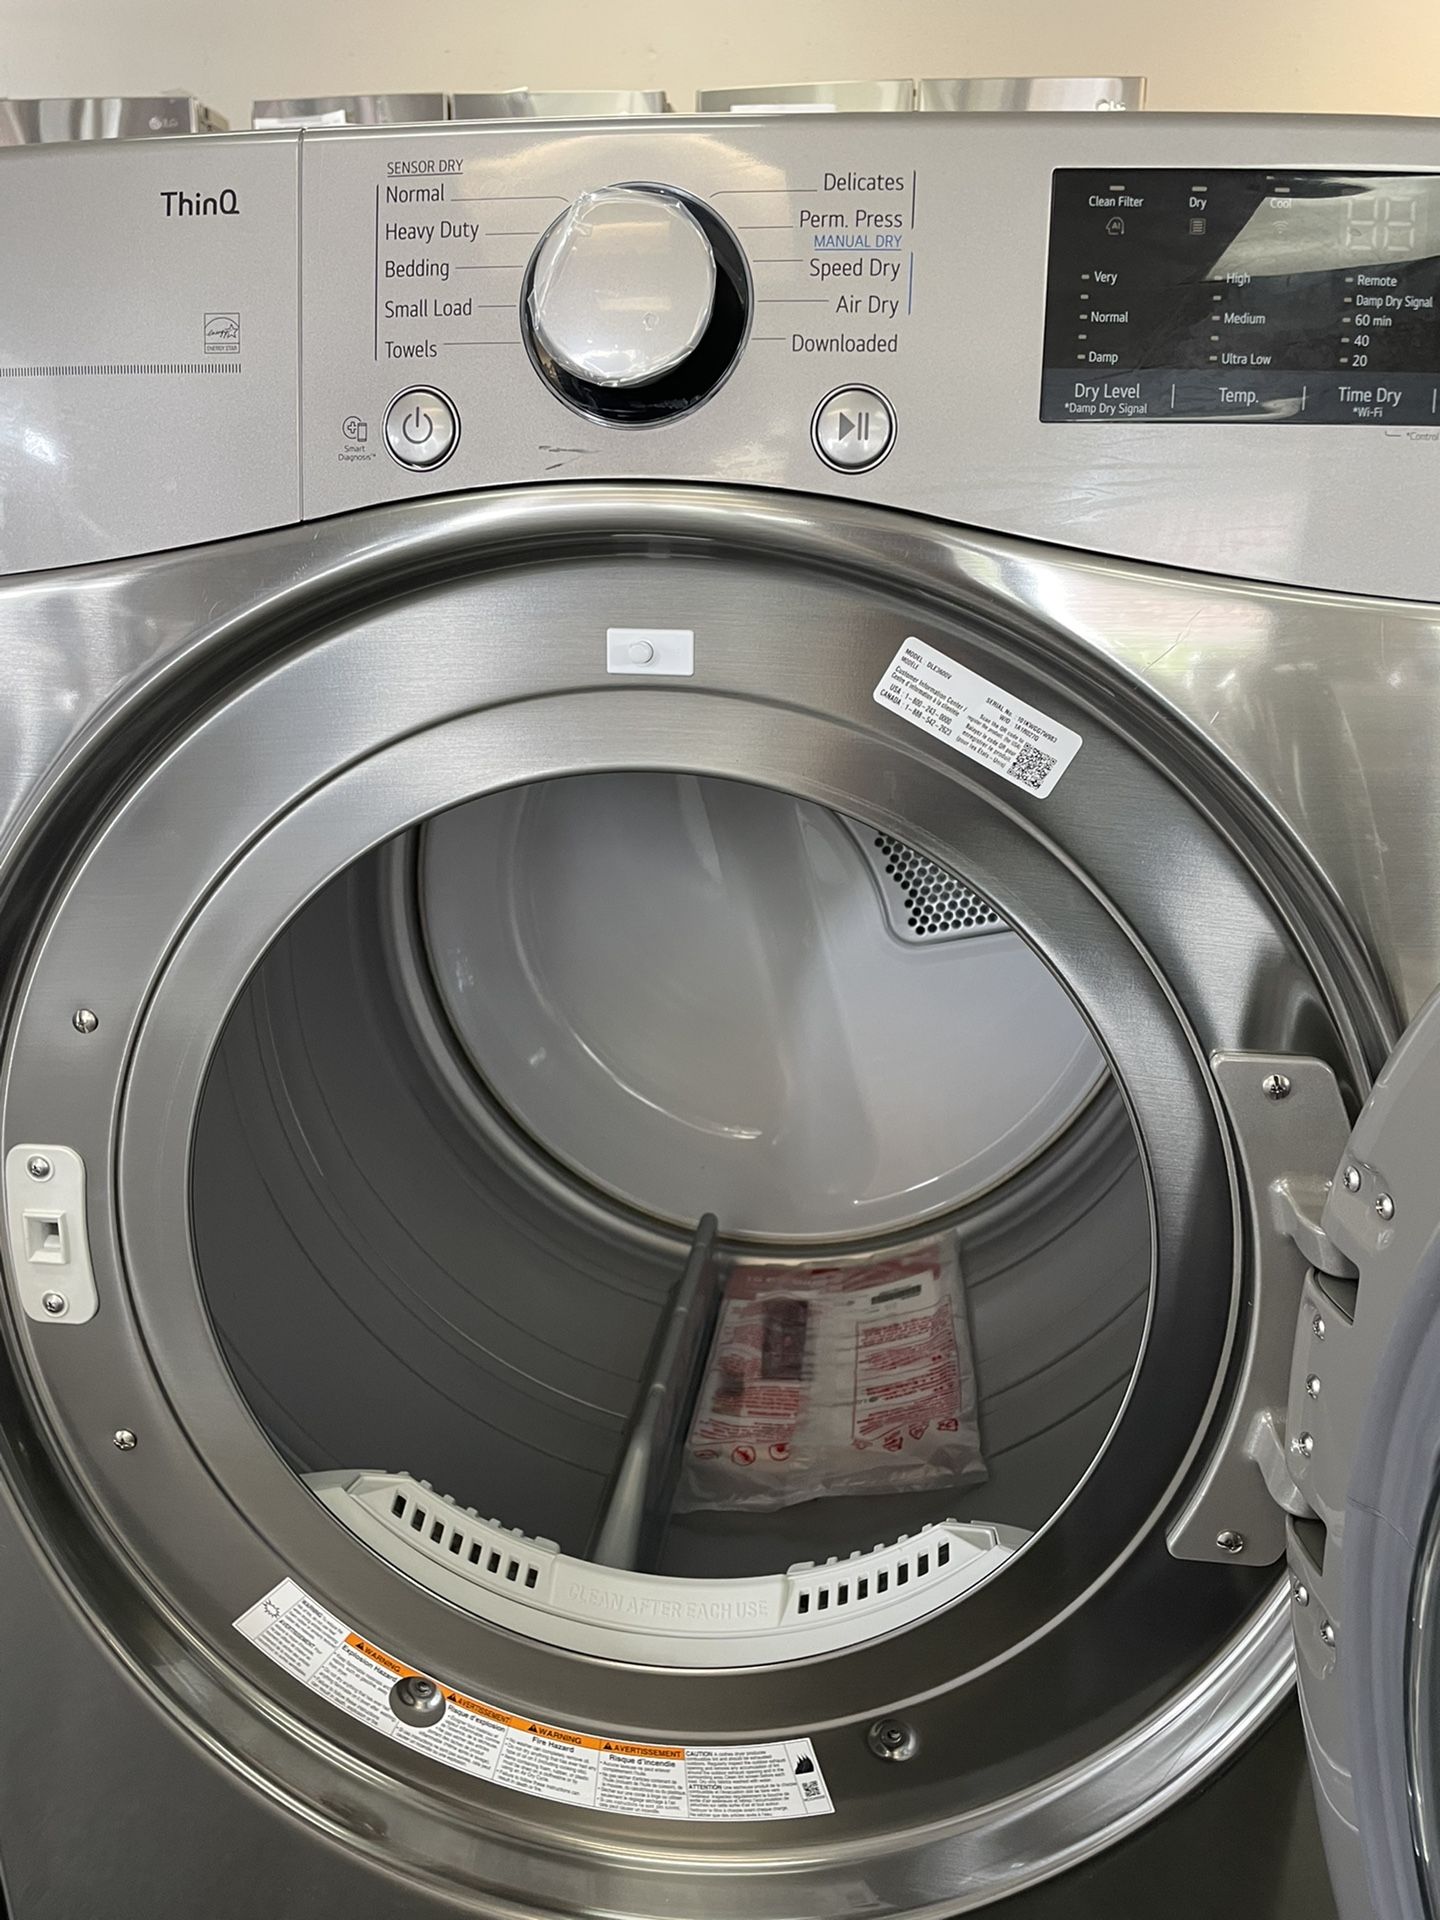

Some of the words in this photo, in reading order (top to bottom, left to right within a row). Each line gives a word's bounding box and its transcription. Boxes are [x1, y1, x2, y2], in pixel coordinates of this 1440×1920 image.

[387, 160, 435, 175] SENSOR
[438, 159, 464, 173] DRY
[824, 172, 904, 191] Delicates
[386, 183, 445, 203] Normal
[160, 189, 240, 217] ThinQ
[1088, 195, 1116, 208] Clean
[1118, 195, 1144, 208] Filter
[1189, 196, 1207, 210] Dry
[1270, 197, 1292, 209] Cool
[800, 209, 849, 228] Perm.
[855, 209, 903, 228] Press
[385, 223, 435, 244] Heavy
[440, 220, 479, 243] Duty
[814, 235, 871, 248] MANUAL
[875, 235, 903, 248] DRY
[385, 259, 450, 281] Bedding
[809, 258, 863, 281] Speed
[869, 258, 901, 282] Dry
[1094, 271, 1118, 285] Very
[1226, 272, 1251, 286] High
[1357, 274, 1398, 287] Remote
[385, 299, 428, 318] Small
[434, 298, 472, 317] Load
[835, 295, 862, 314] Air
[868, 295, 899, 319] Dry
[1356, 294, 1383, 309] Damp
[1385, 295, 1402, 310] Dry
[1404, 295, 1433, 311] Signal
[1090, 311, 1129, 323] Normal
[1223, 312, 1266, 325] Medium
[1354, 314, 1370, 327] 60
[1372, 315, 1393, 327] min
[792, 333, 898, 353] Downloaded
[1353, 334, 1370, 347] 40
[385, 339, 438, 359] Towels
[1088, 351, 1119, 365] Damp
[1221, 352, 1248, 365] Ultra
[1250, 352, 1272, 365] Low
[1352, 354, 1368, 367] 20
[1074, 382, 1100, 402] Dry
[1103, 383, 1140, 399] Level
[1218, 387, 1259, 406] Temp.
[1338, 386, 1372, 402] Time
[1376, 387, 1402, 407] Dry
[1099, 402, 1116, 416] Dry
[1118, 402, 1148, 417] Signal
[344, 445, 365, 453] Smart
[904, 648, 923, 662] MODEL
[888, 683, 902, 694] USA
[894, 665, 919, 683] Customer
[918, 679, 947, 700] Information
[946, 696, 964, 710] Center
[879, 688, 902, 705] CANADA
[985, 696, 1004, 711] SERIAL
[568, 1583, 624, 1611] CLEAN
[627, 1597, 682, 1618] AFTER
[686, 1601, 734, 1620] EACH
[736, 1599, 768, 1619] USE
[341, 1643, 374, 1669] Explosion
[373, 1665, 397, 1682] Hazard
[363, 1646, 401, 1673] WARNING
[447, 1704, 469, 1719] Risque
[457, 1697, 510, 1724] AVERTISSEMENT
[537, 1727, 582, 1744] WARNING
[531, 1736, 546, 1745] Fire
[547, 1741, 574, 1753] Hazard
[614, 1744, 680, 1757] AVERTISSEMENT
[608, 1753, 635, 1764] Risque
